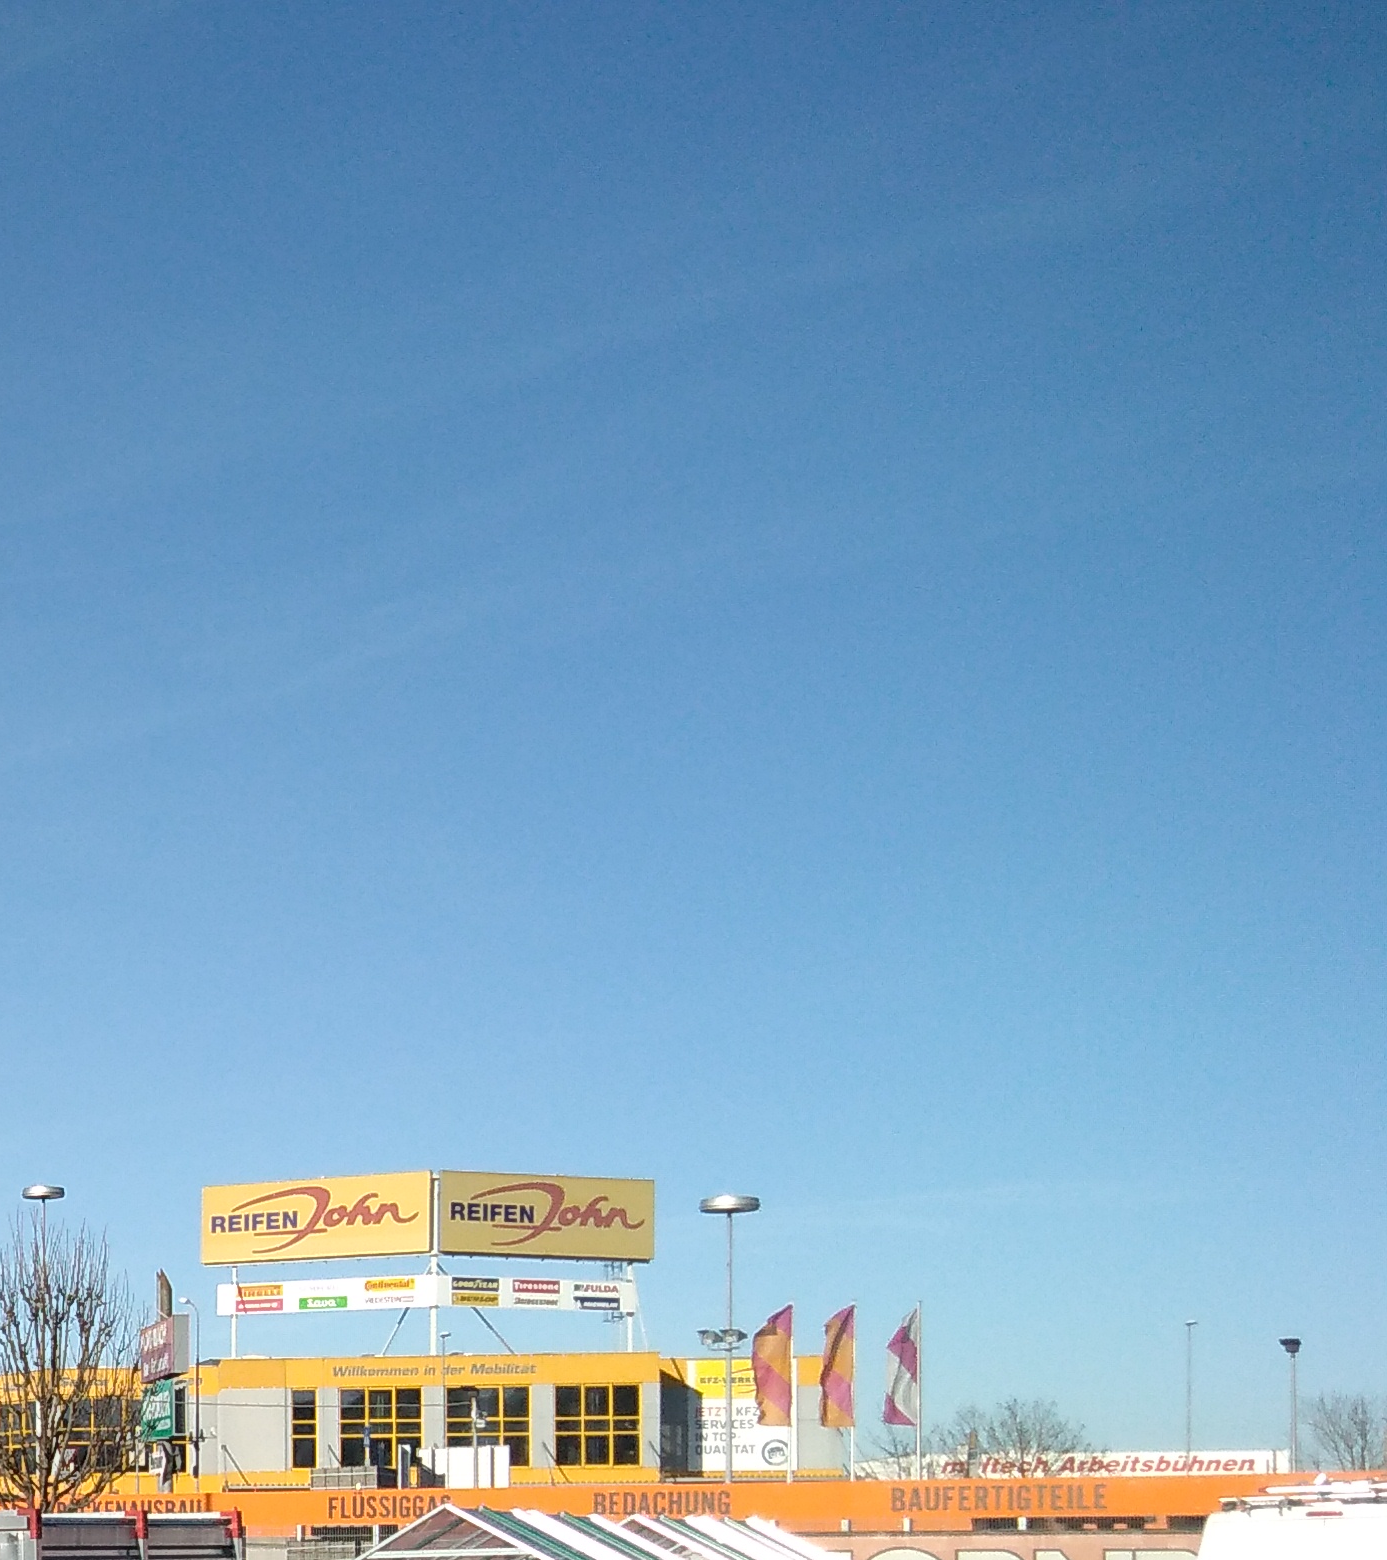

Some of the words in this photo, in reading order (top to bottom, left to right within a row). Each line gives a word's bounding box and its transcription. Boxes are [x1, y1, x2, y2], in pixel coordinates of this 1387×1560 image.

[211, 1211, 299, 1234] REIFEN
[231, 1185, 419, 1254] John
[450, 1201, 535, 1224] REIFEN
[470, 1181, 645, 1247] John
[513, 1281, 559, 1291] Firestone
[584, 1284, 619, 1293] FULDA
[332, 1366, 420, 1377] Willkommen
[423, 1366, 436, 1376] in
[442, 1365, 465, 1376] der
[470, 1363, 537, 1375] Mobilität
[695, 1419, 755, 1430] SERVCES
[941, 1456, 1049, 1474] mltech
[1057, 1454, 1256, 1474] Arbeitsbühnen
[593, 1490, 732, 1518] BEDACHUNG
[891, 1484, 1108, 1513] BAUFERTIGTEILE
